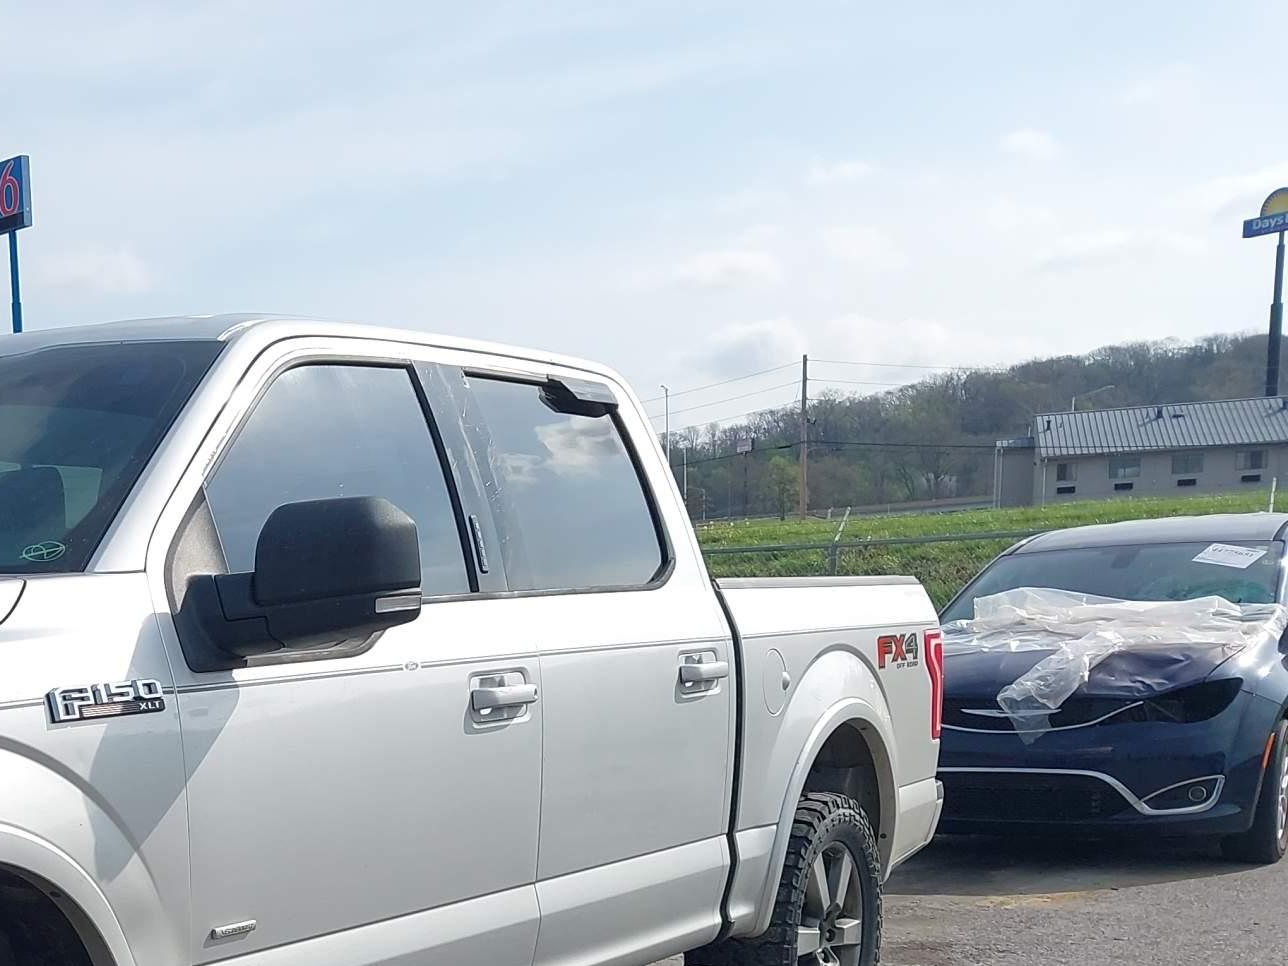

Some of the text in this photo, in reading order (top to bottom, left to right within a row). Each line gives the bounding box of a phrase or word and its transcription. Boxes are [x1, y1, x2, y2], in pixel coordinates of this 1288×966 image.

[1252, 215, 1284, 230] Days
[877, 632, 919, 670] FX4
[139, 700, 161, 710] XLT
